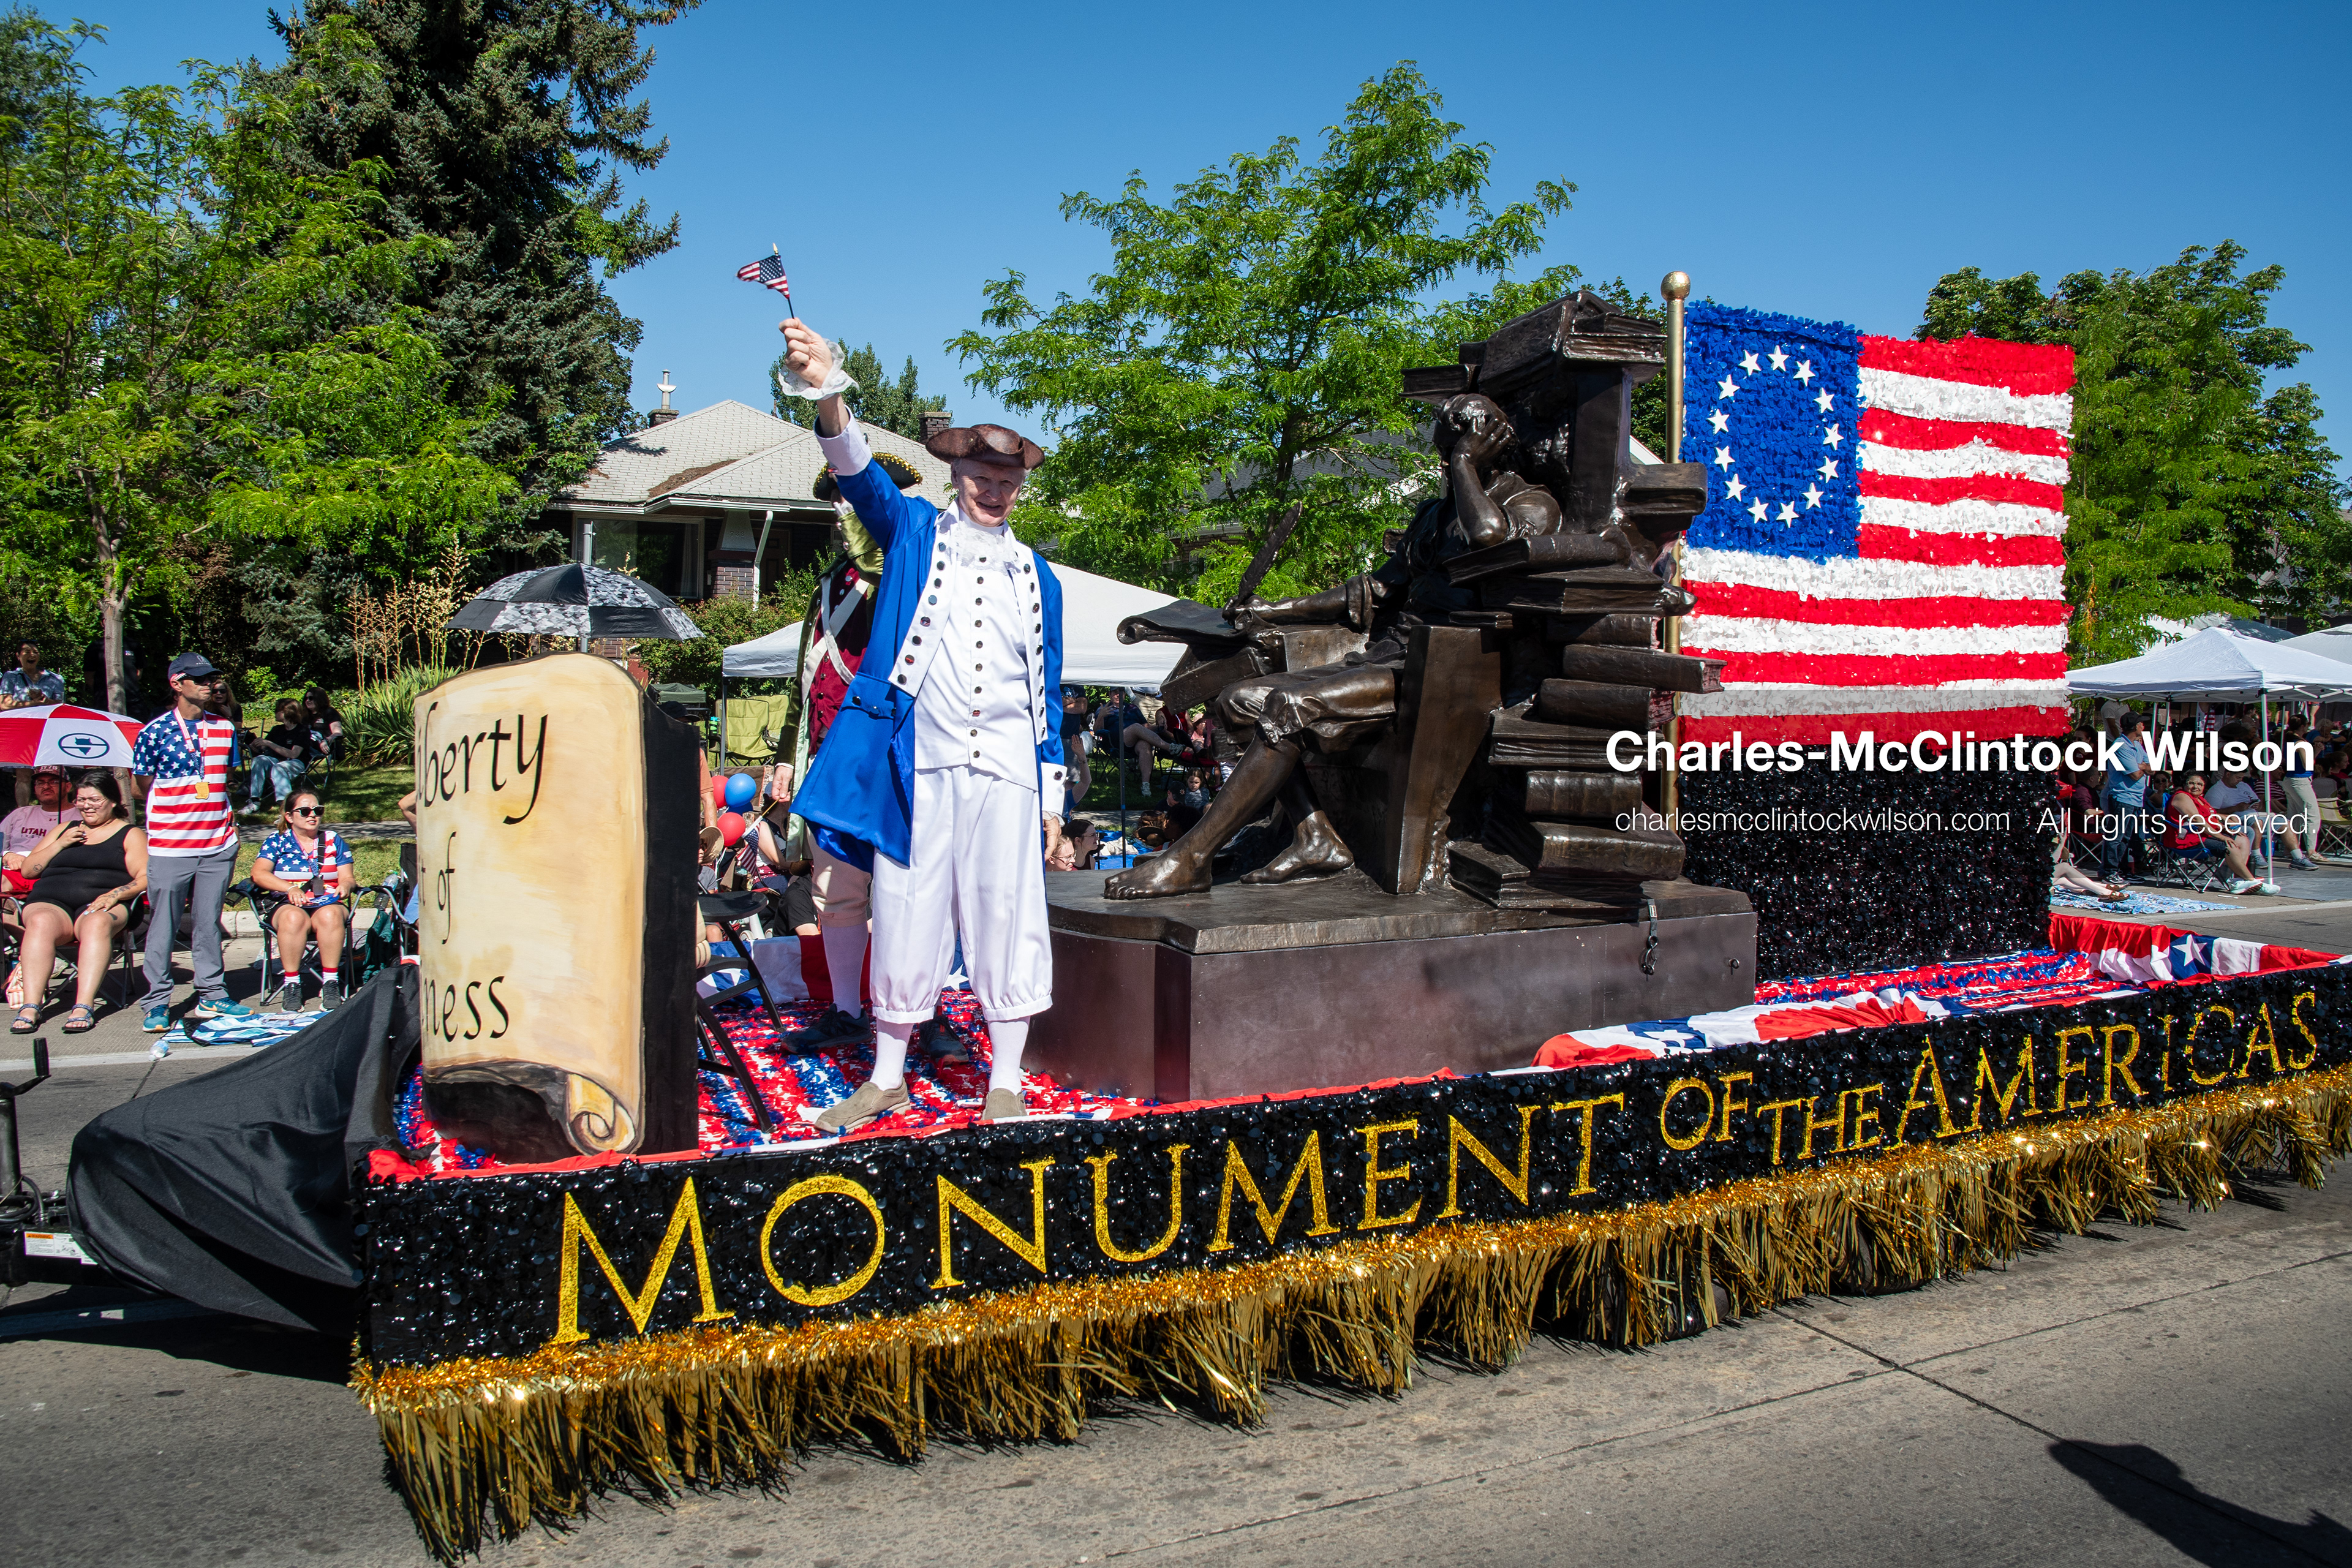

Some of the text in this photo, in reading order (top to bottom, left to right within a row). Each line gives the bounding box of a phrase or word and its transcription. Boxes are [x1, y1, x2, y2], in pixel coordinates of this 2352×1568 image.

[416, 701, 548, 825] iberty
[21, 827, 47, 837] UTAH
[437, 831, 457, 944] of
[550, 992, 2318, 1344] MONUMENT OF THE AMERICAS
